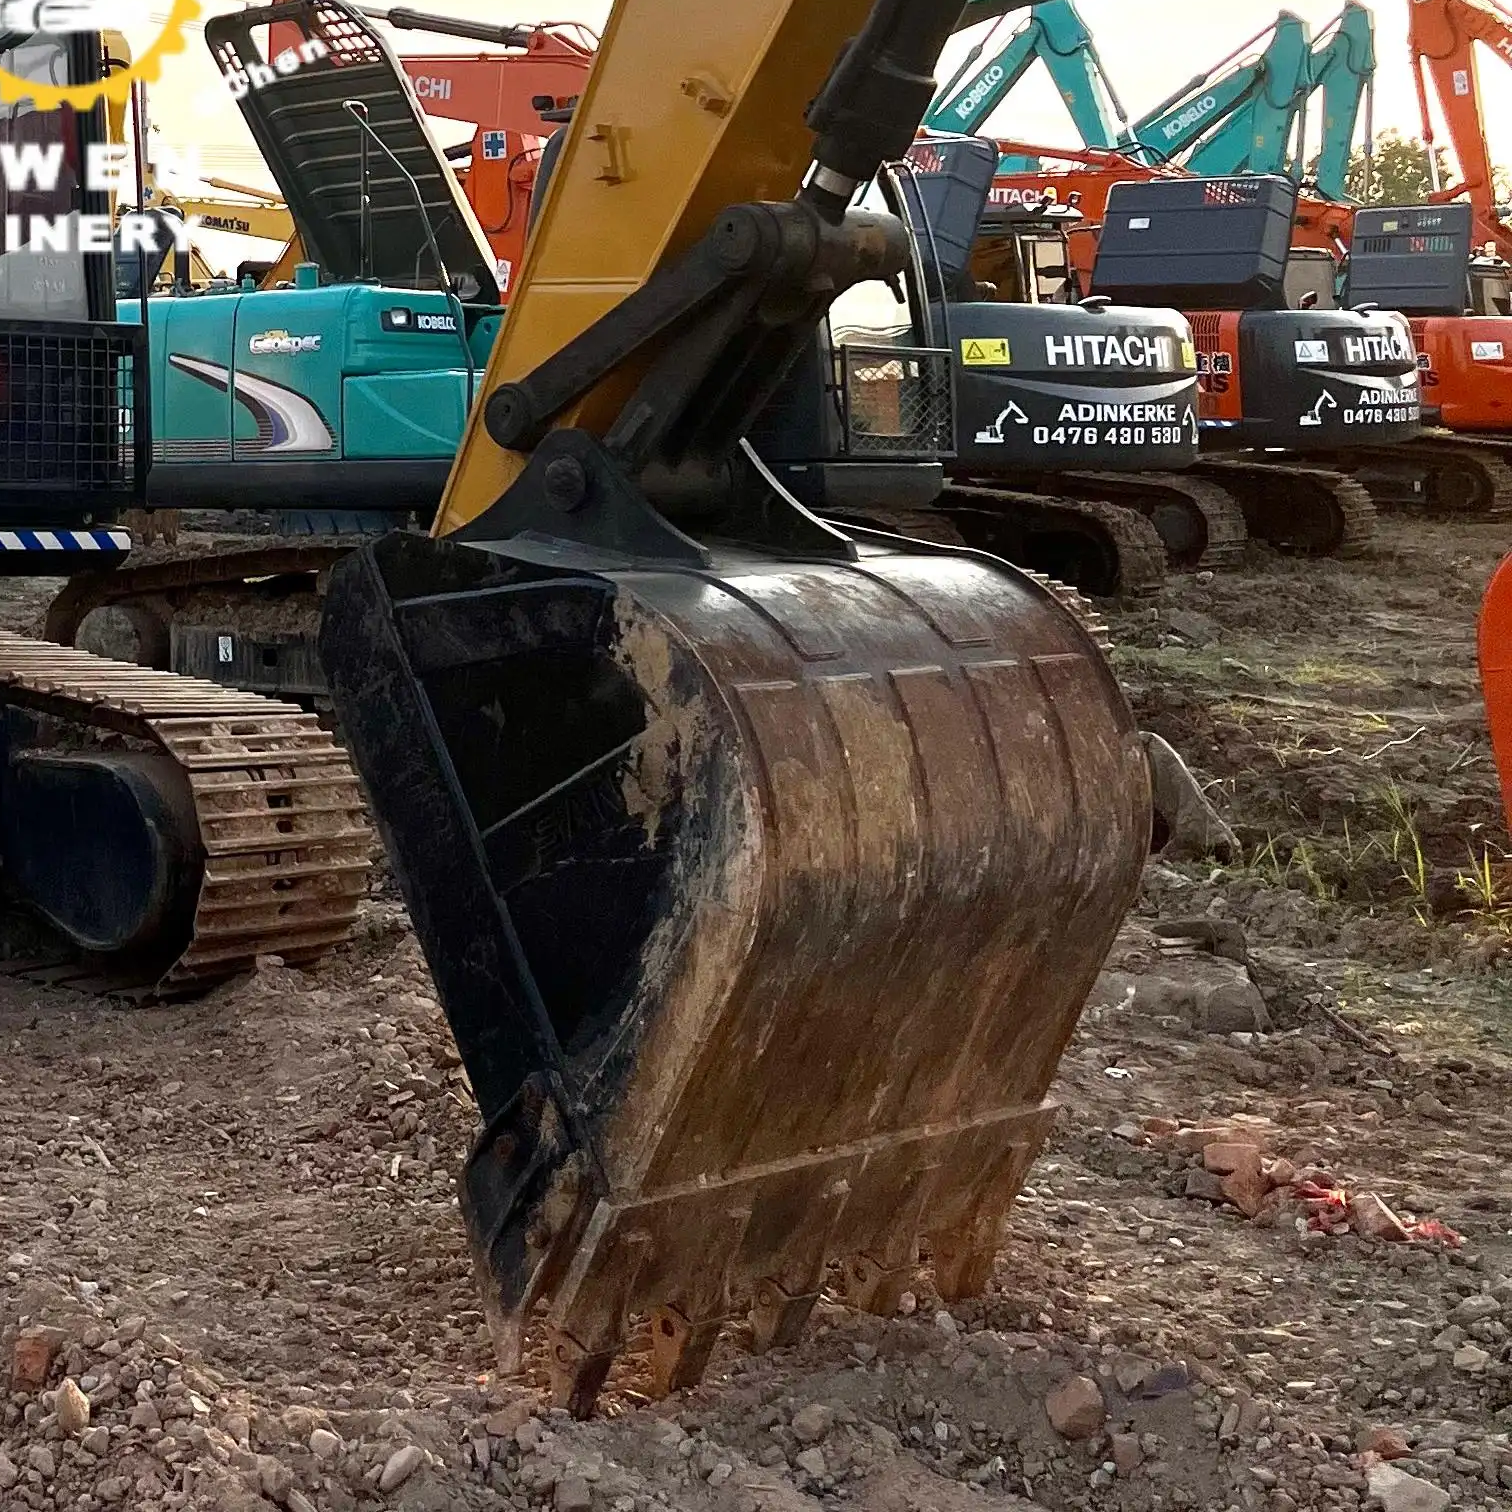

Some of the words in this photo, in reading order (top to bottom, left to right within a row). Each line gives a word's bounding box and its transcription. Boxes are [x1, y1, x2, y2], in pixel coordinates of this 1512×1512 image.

[408, 74, 452, 100] CHI
[955, 65, 1004, 120] KOBELCO
[1162, 96, 1216, 139] KOBELCO
[1045, 335, 1171, 367] HITACHI
[1058, 403, 1176, 422] ADINKERKE
[1033, 426, 1098, 445] 0476
